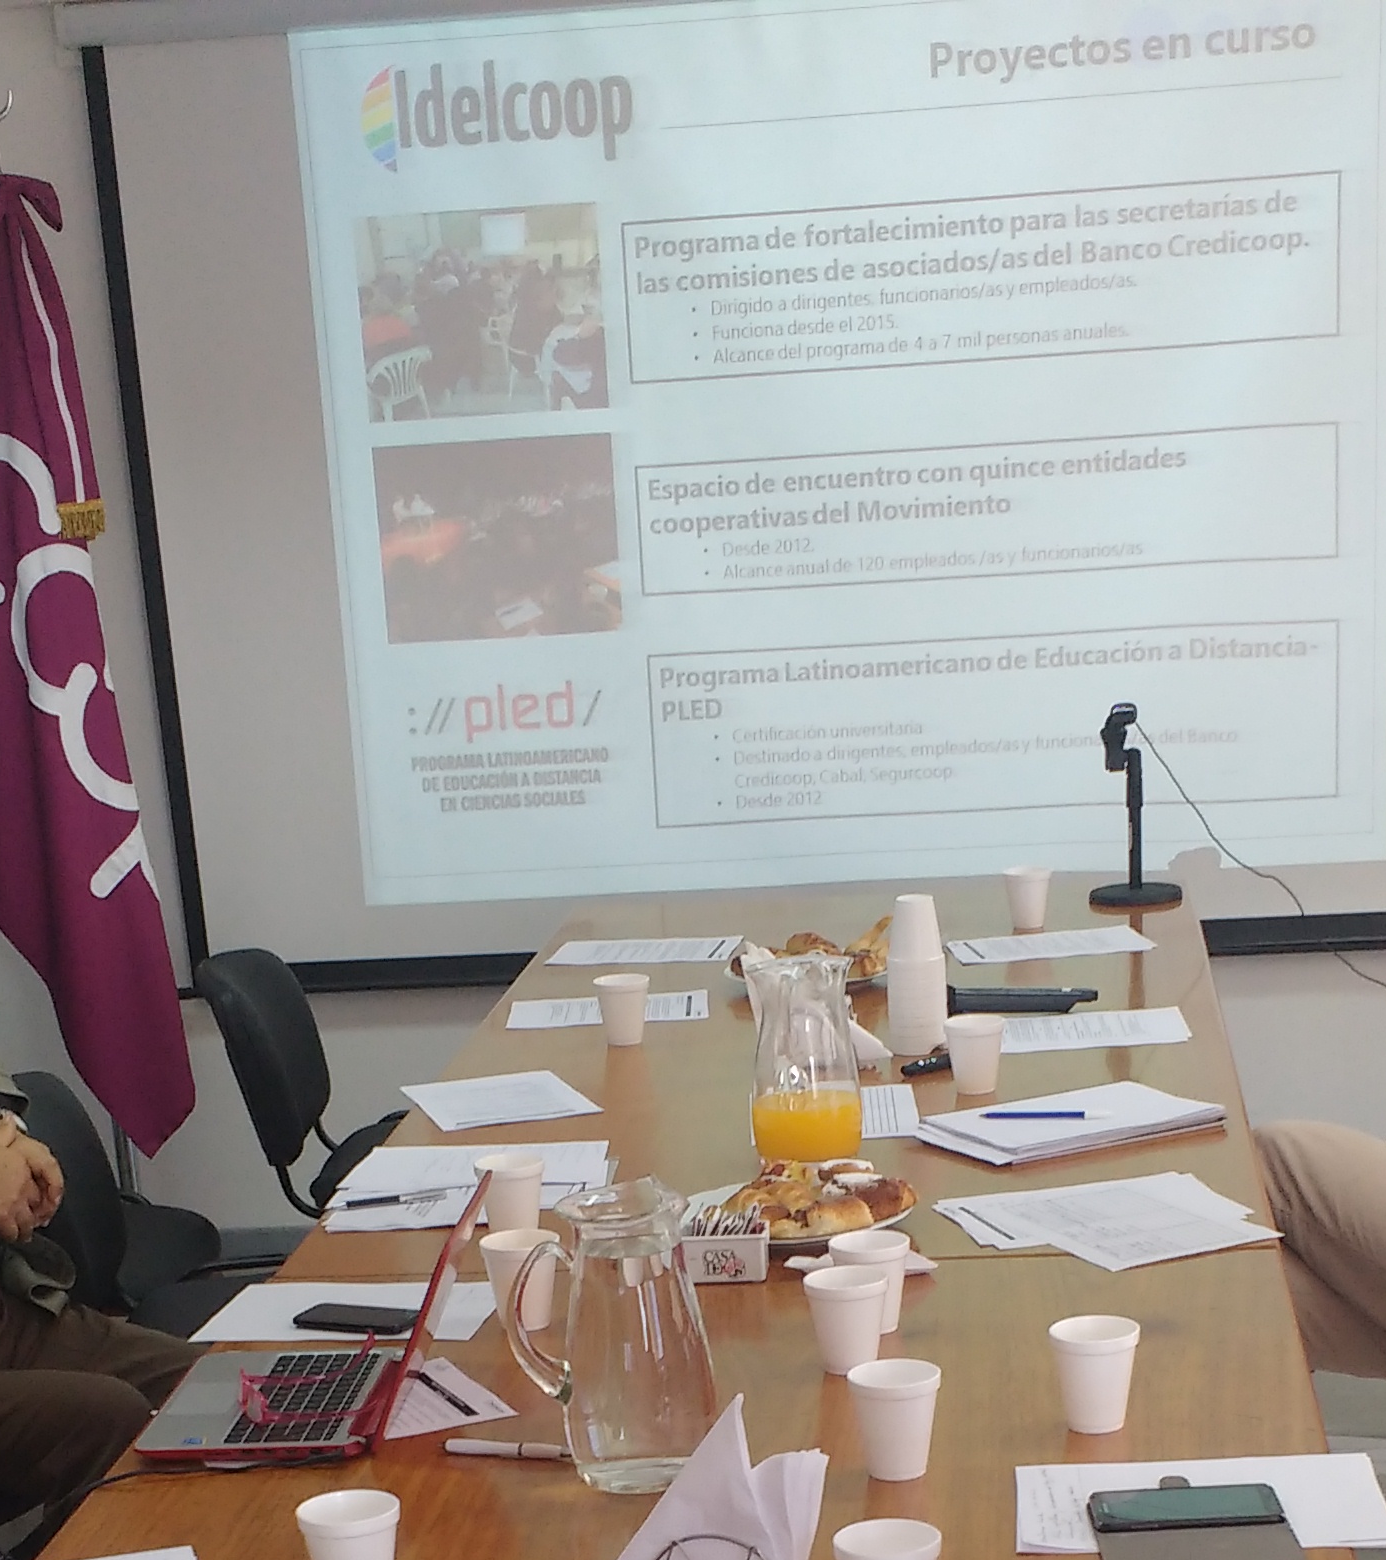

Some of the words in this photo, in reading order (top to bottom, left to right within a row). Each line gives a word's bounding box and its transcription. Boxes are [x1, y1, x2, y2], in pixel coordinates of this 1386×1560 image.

[929, 34, 1132, 83] Proyectos
[1143, 31, 1191, 61] en
[1204, 21, 1315, 55] curso
[394, 60, 633, 161] Idelcoop
[634, 230, 759, 262] Programa
[765, 226, 797, 250] de
[804, 215, 1004, 248] fortalecimiento
[1009, 209, 1067, 239] para
[1074, 203, 1109, 229] las
[1116, 193, 1257, 225] secretarías
[1264, 191, 1297, 215] de
[637, 270, 670, 295] las
[676, 262, 818, 292] comisiones
[824, 260, 856, 283] de
[863, 246, 1028, 280] asociados/as
[1034, 242, 1072, 268] del
[1081, 236, 1162, 264] Banco
[1168, 230, 1311, 260] Credicoop.
[710, 297, 773, 318] Dirigido
[778, 299, 787, 312] a
[879, 281, 1003, 306] funcionarios/as
[1006, 283, 1015, 299] y
[1019, 272, 1138, 298] empleados/as.
[711, 321, 783, 342] Funciona
[787, 317, 835, 338] desde
[839, 316, 853, 334] el
[857, 314, 899, 333] 2015.
[713, 345, 774, 365] Alcance
[777, 342, 803, 361] del
[806, 340, 886, 361] programa
[888, 337, 908, 354] de
[914, 336, 923, 351] 4
[928, 338, 937, 350] a
[942, 334, 951, 349] 7
[958, 331, 982, 348] mil
[986, 327, 1058, 349] personas
[648, 477, 737, 504] Espacio
[745, 472, 776, 494] de
[784, 467, 911, 493] encuentro
[917, 464, 962, 484] con
[969, 456, 1056, 487] quince
[1061, 448, 1187, 477] entidades
[649, 506, 808, 537] cooperativas
[813, 501, 850, 525] del
[858, 494, 1012, 522] Movimiento
[722, 540, 770, 557] Desde
[723, 562, 784, 580] Alcance
[786, 560, 830, 577] anual
[832, 558, 852, 574] de
[858, 556, 885, 573] 120
[1006, 549, 1016, 567] y
[659, 665, 779, 692] Programa
[784, 655, 991, 682] Latinoamericano
[998, 650, 1027, 671] de
[1034, 641, 1162, 668] Educación
[1168, 646, 1182, 660] a
[661, 699, 722, 721] PLED
[732, 725, 827, 744] Certificación
[830, 720, 923, 738] universitaria
[410, 753, 485, 772] PROGRAMA
[487, 747, 609, 768] LATINOAMERICANO
[734, 747, 808, 767] Destinado
[422, 775, 439, 792] DE
[520, 772, 531, 788] A
[533, 767, 602, 786] DISTANCIA
[440, 796, 457, 812] EN
[459, 792, 521, 810] CIENCIAS
[523, 789, 586, 808] SOCIALES
[735, 792, 783, 810] Desde
[786, 790, 823, 808] 2012
